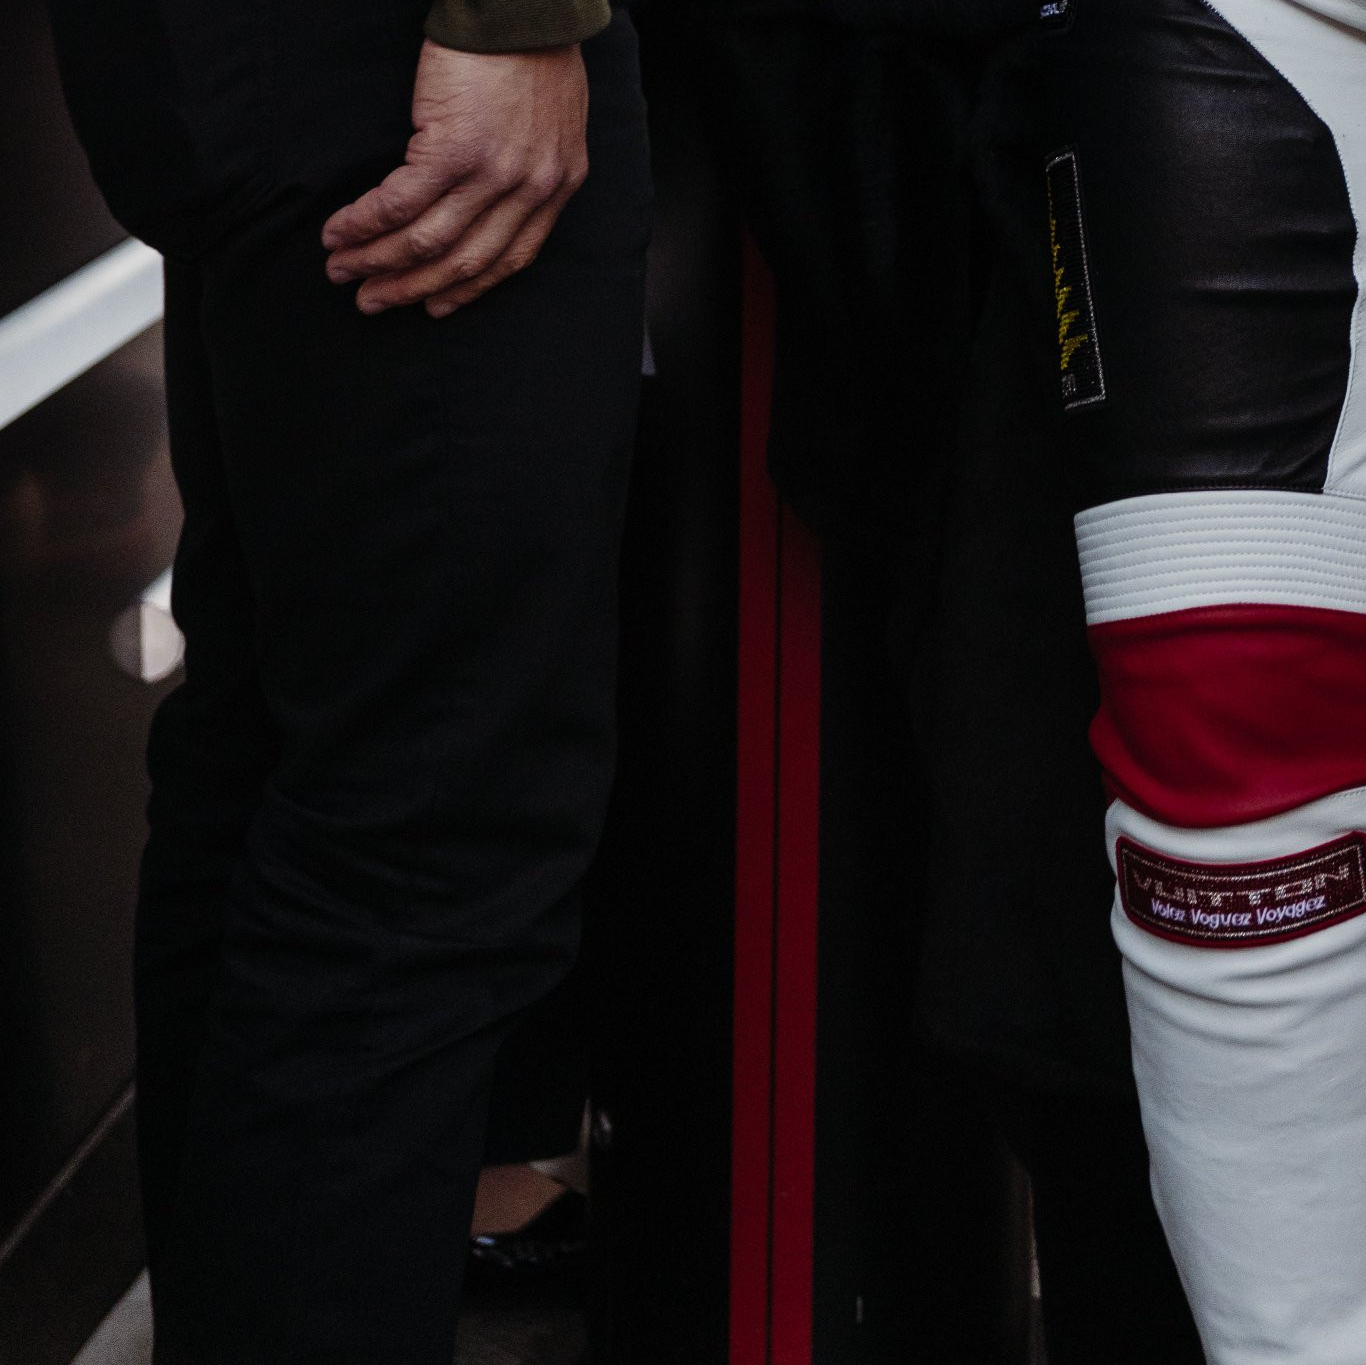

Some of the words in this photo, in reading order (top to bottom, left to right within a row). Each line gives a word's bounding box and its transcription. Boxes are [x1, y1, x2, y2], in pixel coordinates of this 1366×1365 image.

[1133, 863, 1350, 907] VUITTON
[1192, 908, 1251, 930] Voguez
[1257, 894, 1328, 924] Voyagez
